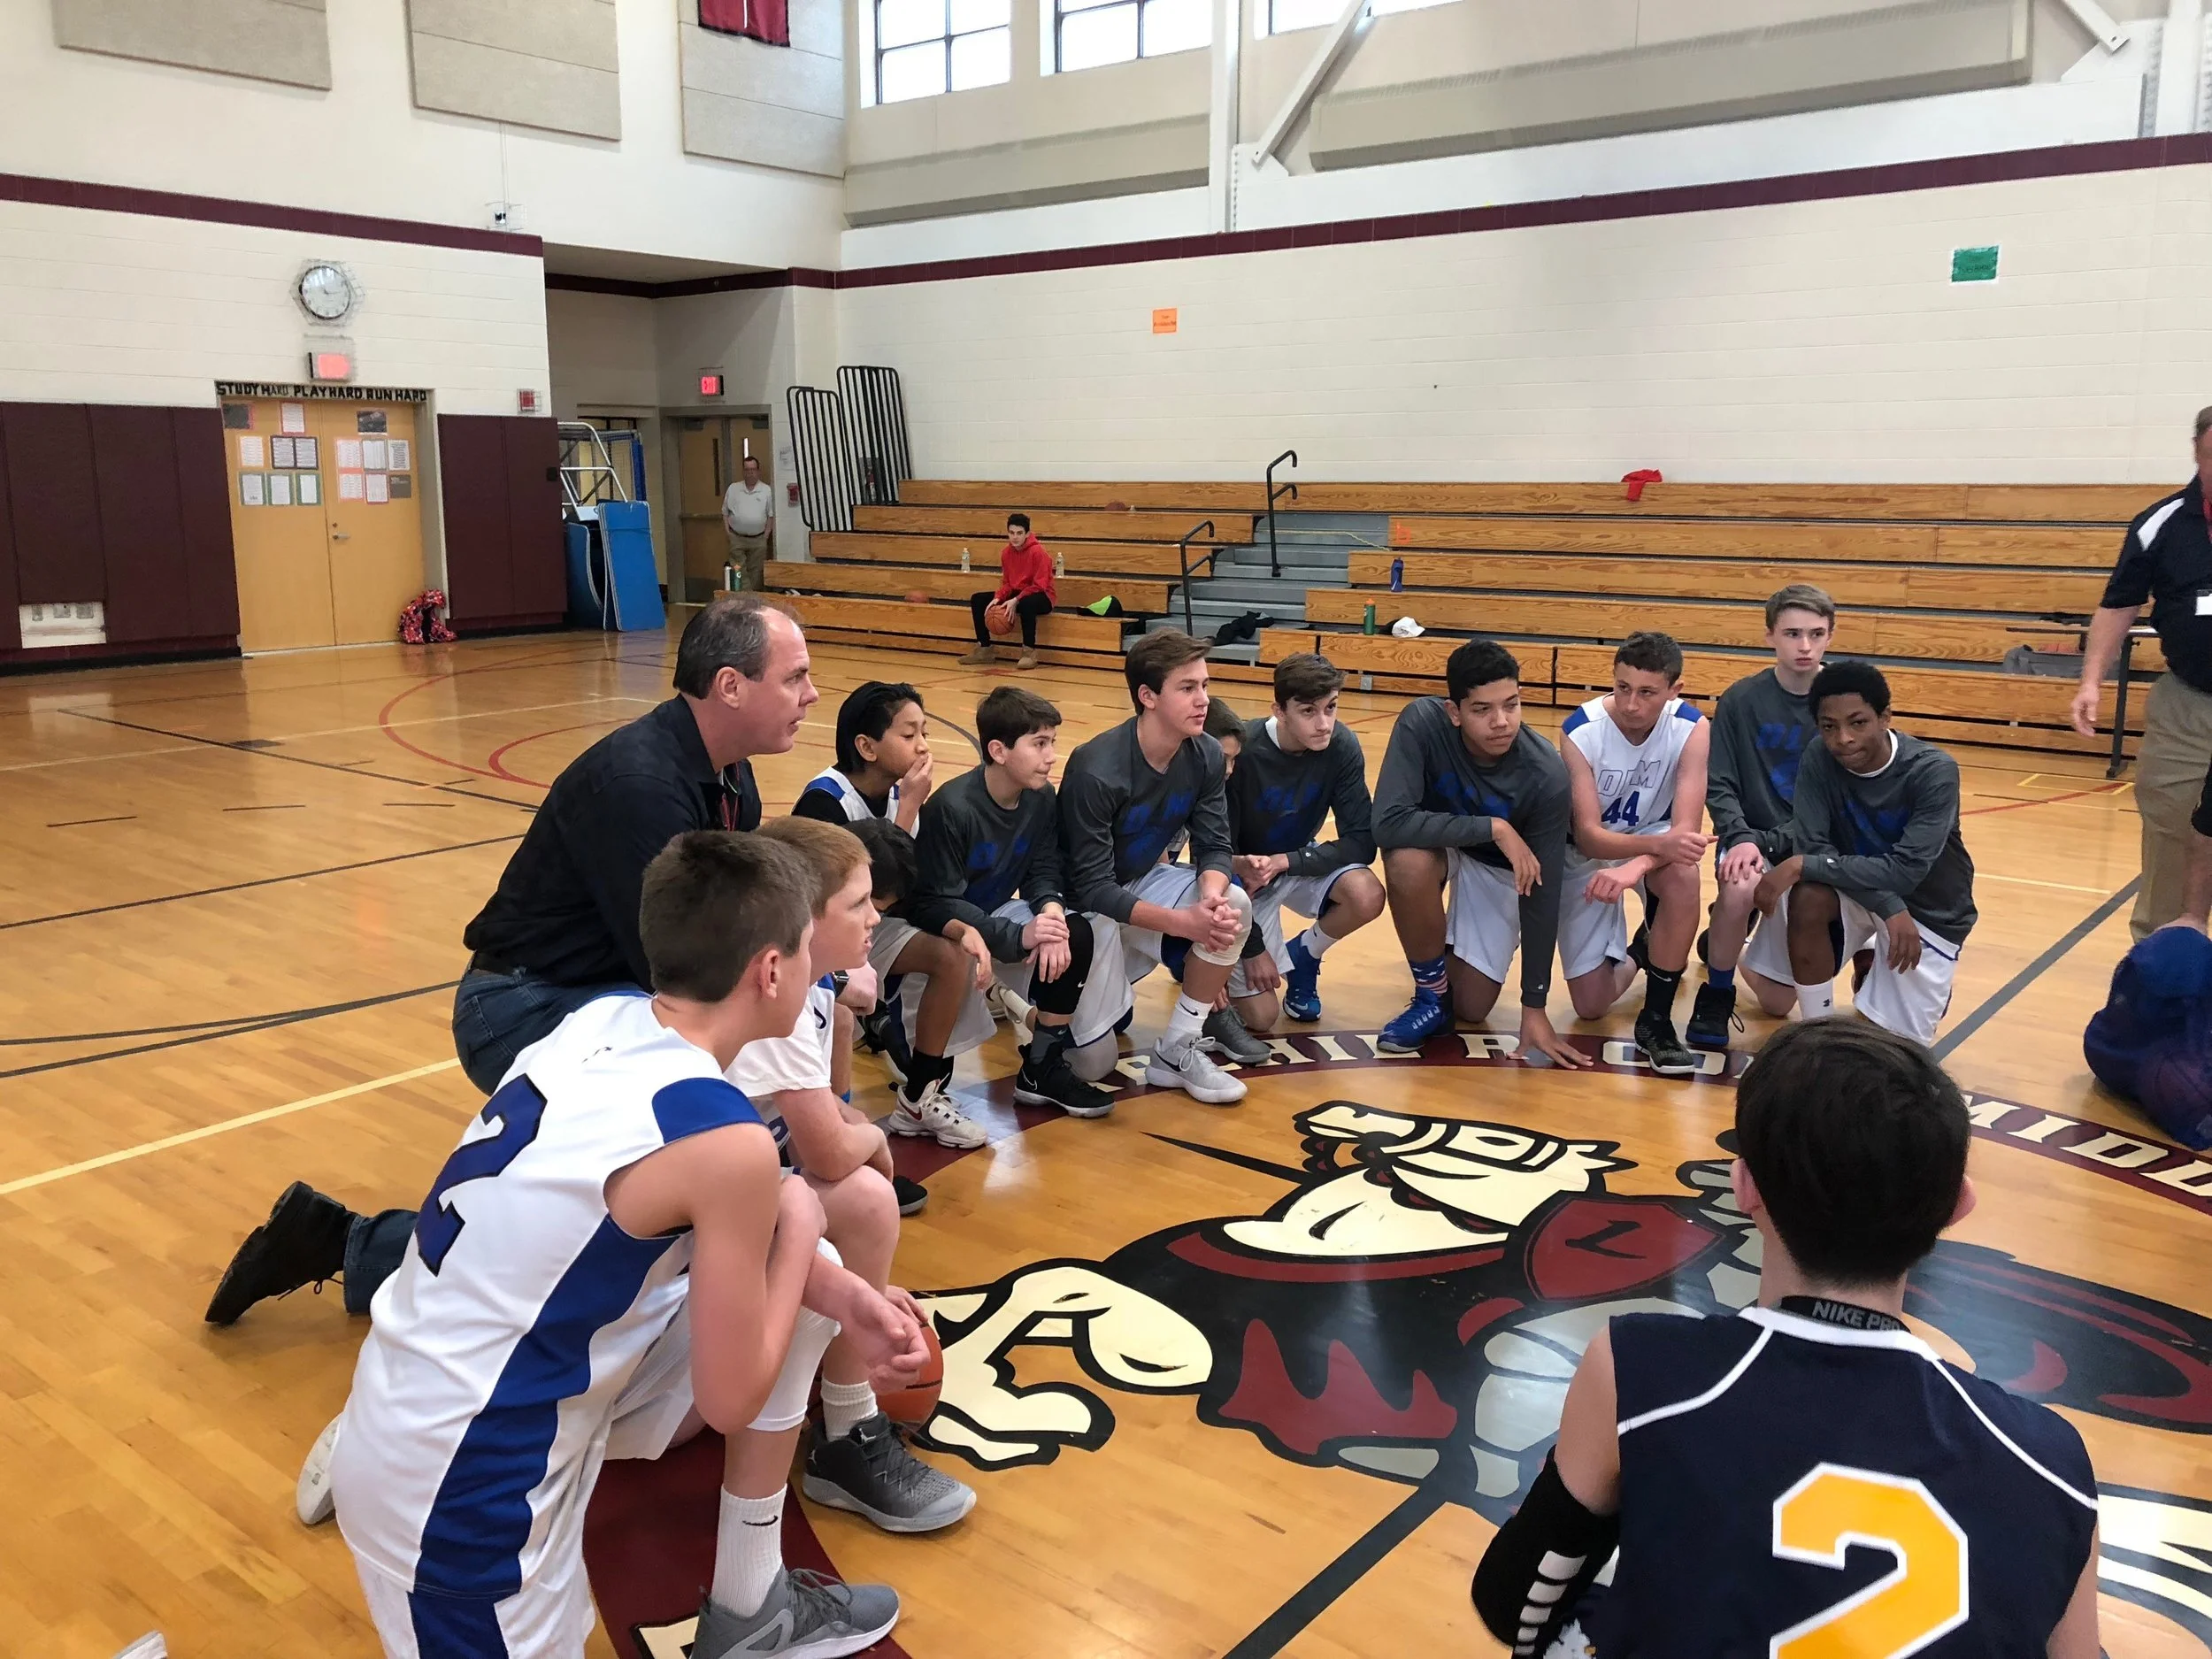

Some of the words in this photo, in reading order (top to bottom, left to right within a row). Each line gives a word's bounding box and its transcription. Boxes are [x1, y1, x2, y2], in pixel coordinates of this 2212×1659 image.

[215, 381, 259, 396] STUDY
[294, 384, 327, 397] PLAY
[366, 388, 392, 400] RUN
[395, 388, 426, 402] HARD
[1601, 790, 1633, 827] 44
[415, 1072, 548, 1277] 2
[1812, 1301, 1864, 1328] NIKE
[1770, 1463, 1970, 1659] 2
